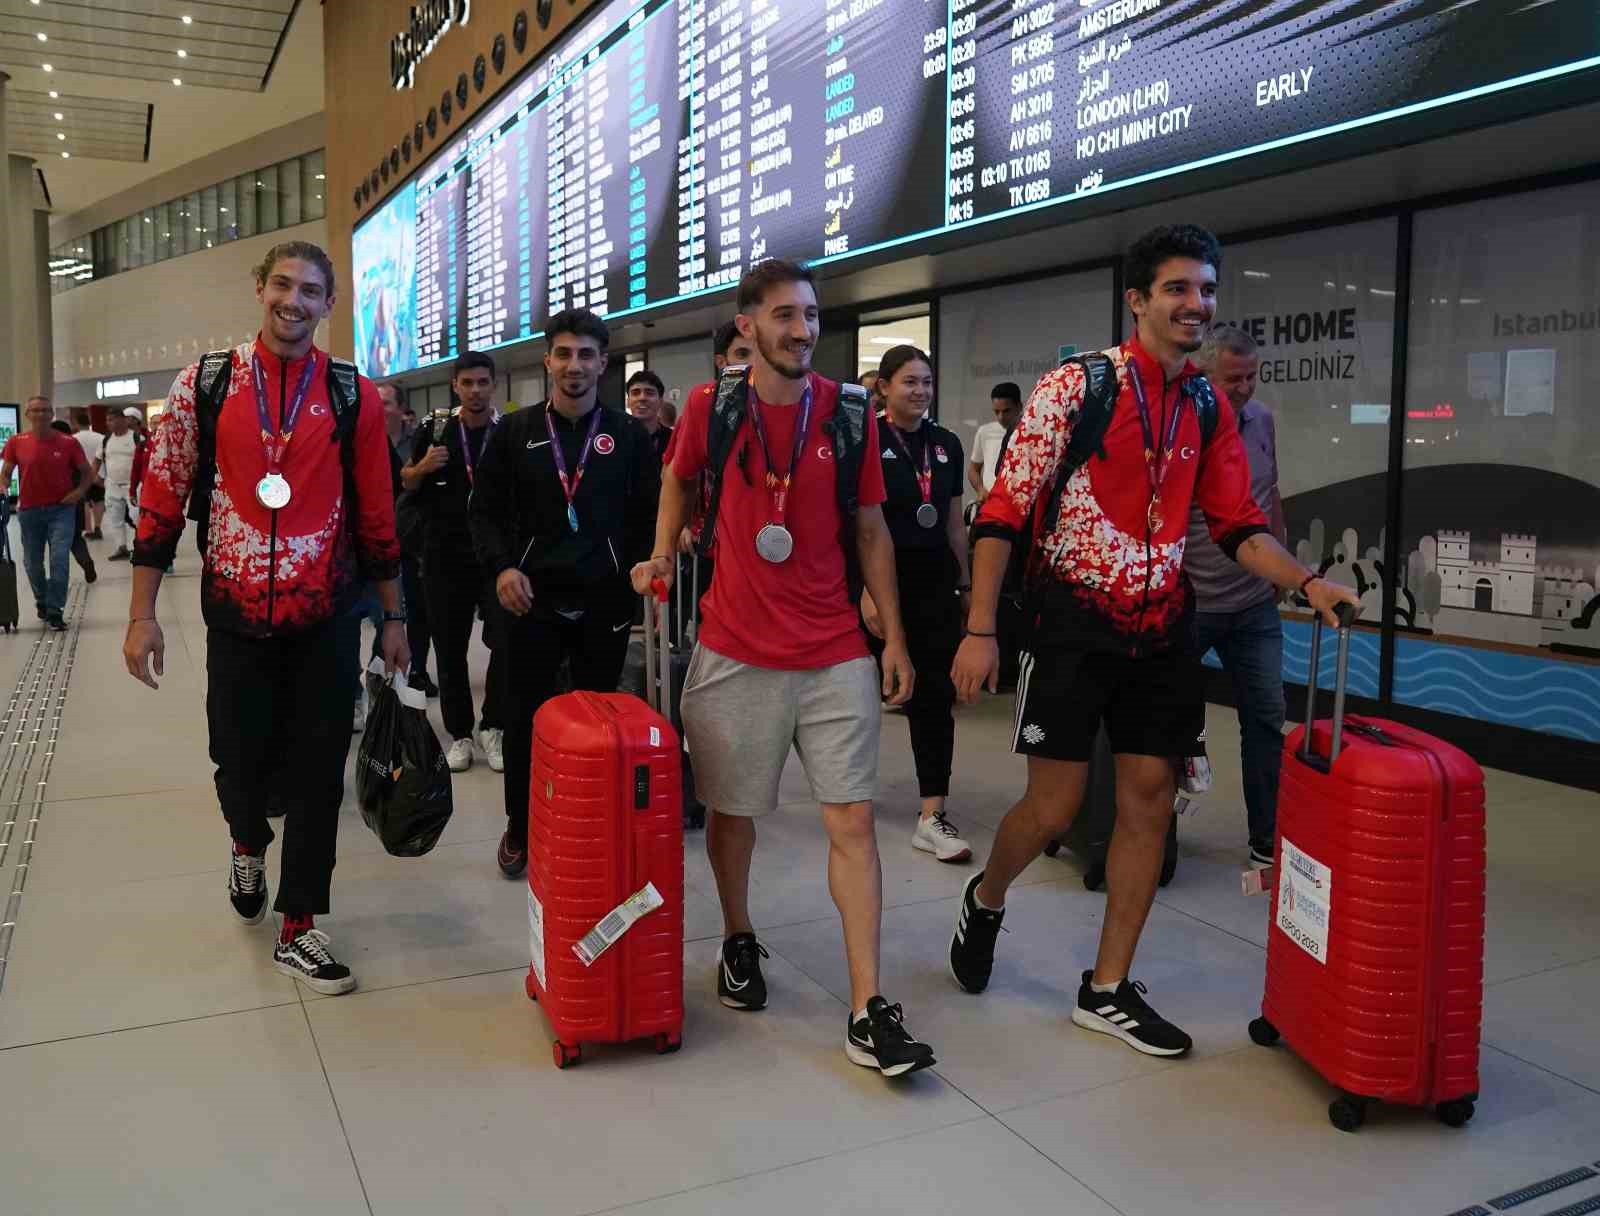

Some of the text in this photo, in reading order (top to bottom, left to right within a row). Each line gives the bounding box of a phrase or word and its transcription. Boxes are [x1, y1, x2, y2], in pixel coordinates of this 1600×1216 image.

[826, 72, 855, 100] LANDED
[826, 96, 854, 122] LANDED
[848, 106, 883, 135] DELAYED
[1009, 128, 1026, 151] AV
[1027, 120, 1052, 146] 6616
[1077, 92, 1130, 130] LONDON
[1133, 78, 1169, 115] (LHR)
[1011, 99, 1026, 123] AH
[1028, 91, 1053, 117] 3018
[950, 66, 1313, 197] 04:15 03:10 TK 0163 HO CHI MINH CITY EARLY
[949, 199, 973, 223] 04:15
[1009, 185, 1024, 207] TK
[1273, 308, 1357, 345] HOME
[1259, 350, 1355, 384] GELDİNİZ
[1302, 933, 1319, 955] 2023
